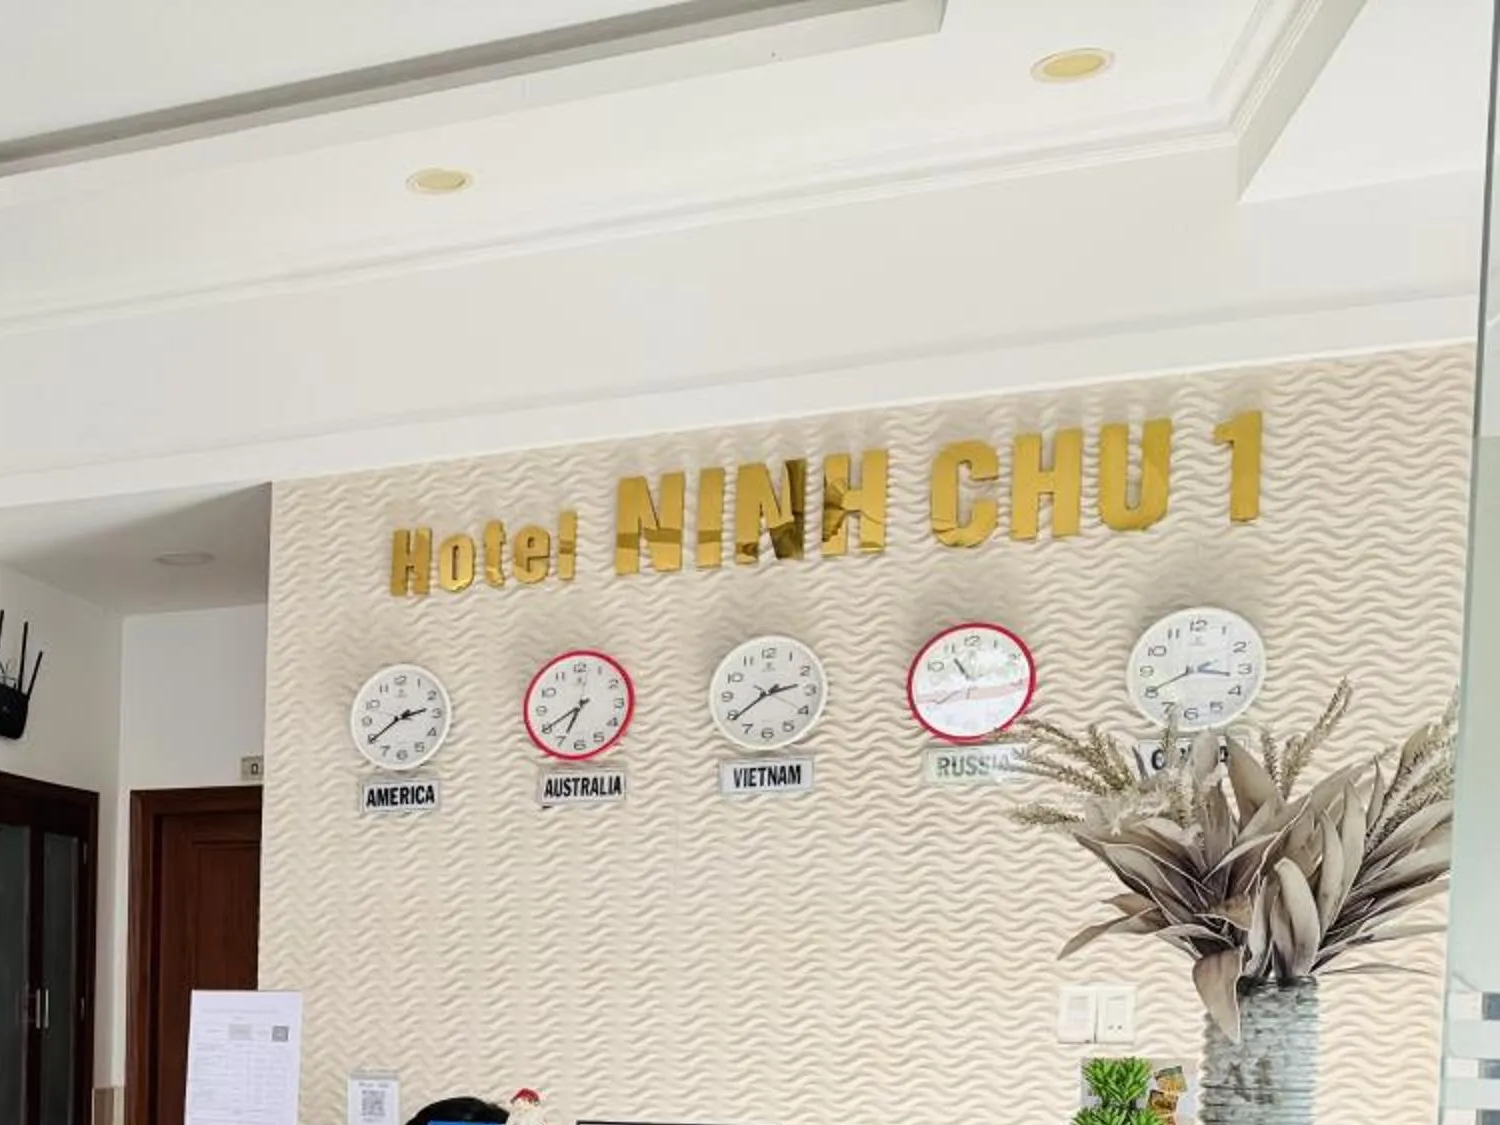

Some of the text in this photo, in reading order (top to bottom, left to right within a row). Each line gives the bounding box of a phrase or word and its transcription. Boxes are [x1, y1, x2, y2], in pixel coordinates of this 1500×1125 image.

[390, 410, 1262, 596] Hotel NINH CHU 1
[544, 776, 622, 797] AUSTRALIA
[733, 764, 801, 788] VIETNAM
[366, 784, 435, 807] AMERICA
